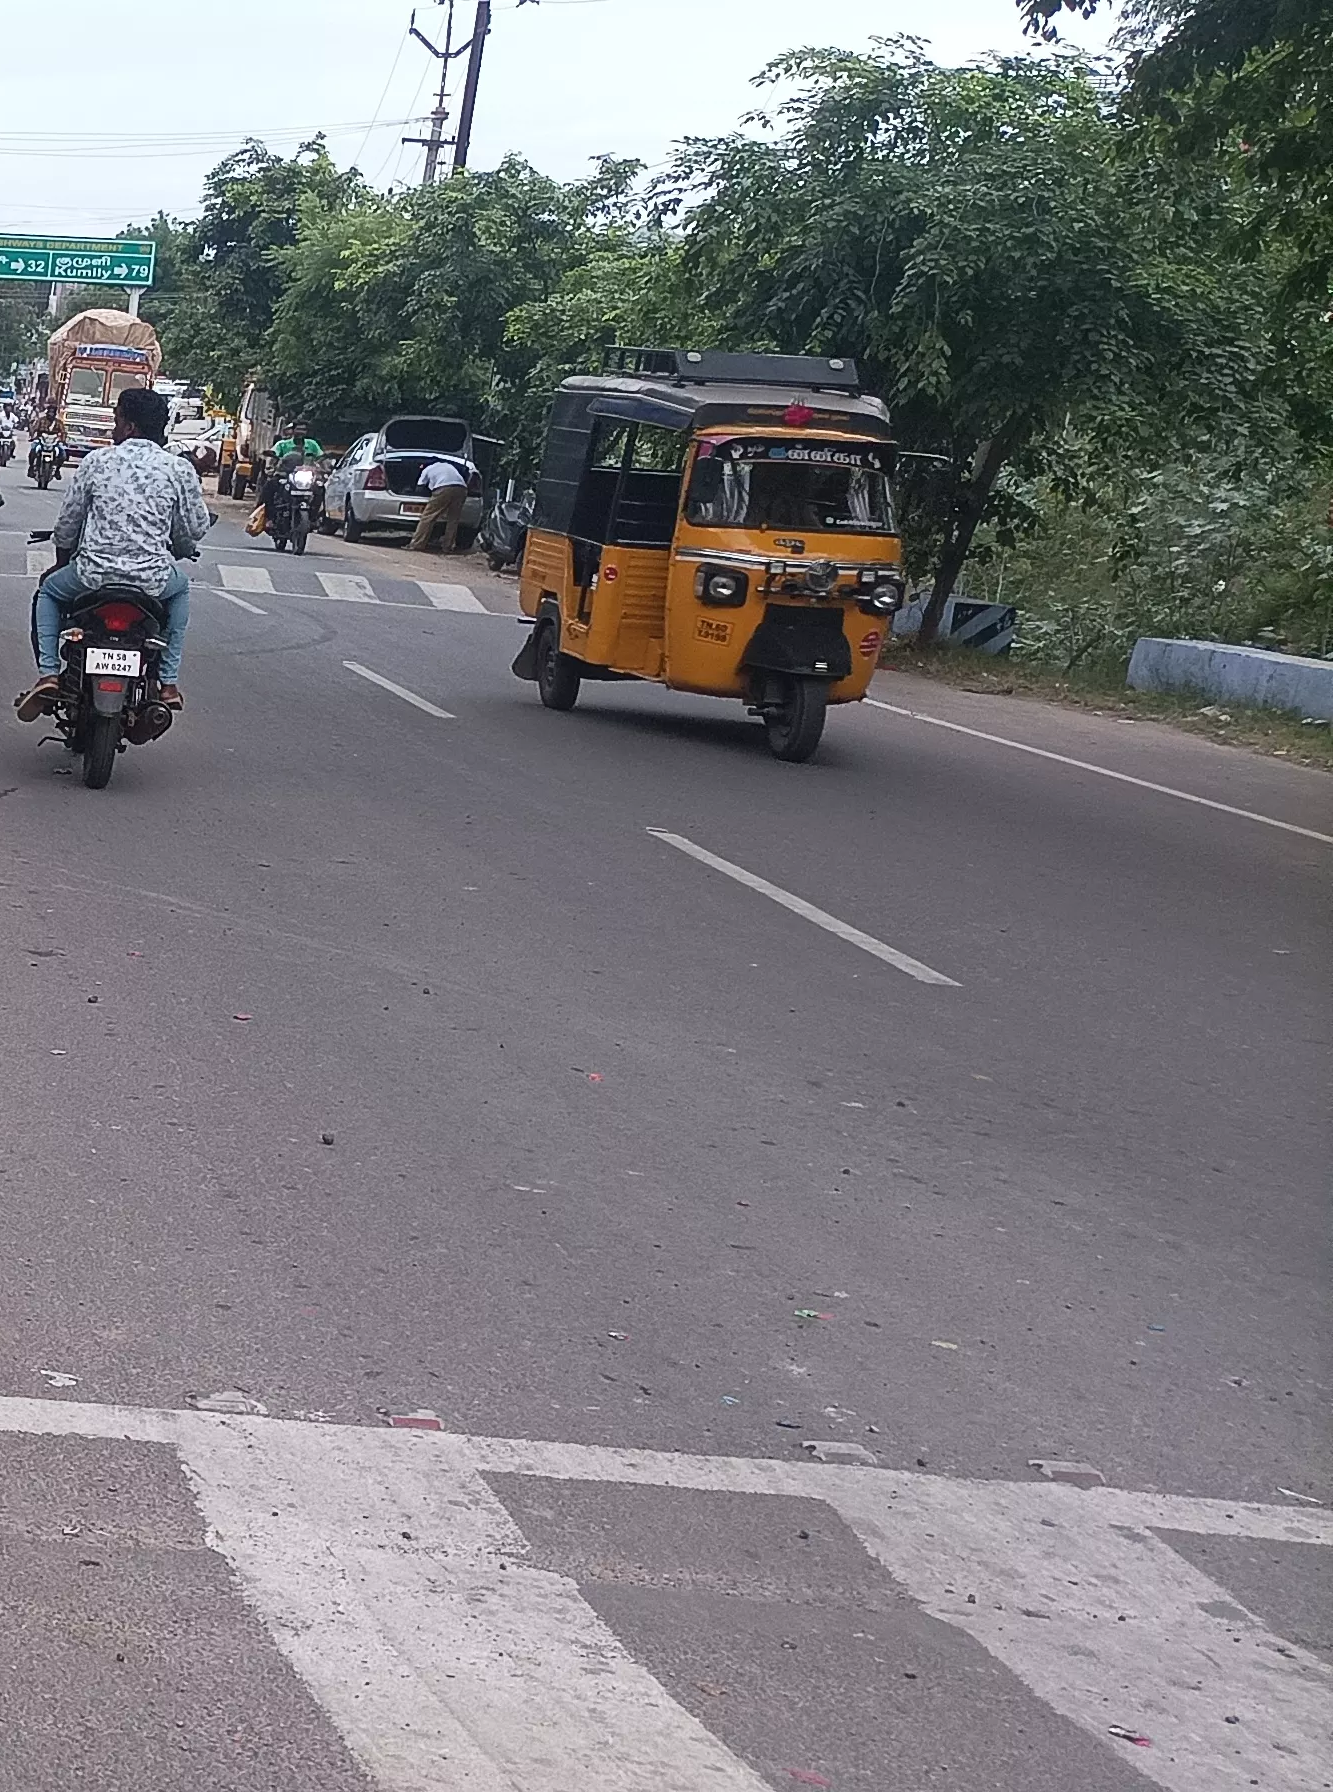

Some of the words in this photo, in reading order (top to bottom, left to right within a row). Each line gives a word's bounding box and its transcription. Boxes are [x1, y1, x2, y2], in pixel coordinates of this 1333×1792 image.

[46, 239, 124, 253] DEPARTMENT
[27, 259, 45, 273] 32
[55, 255, 111, 269] குமுளி
[130, 264, 149, 278] 79
